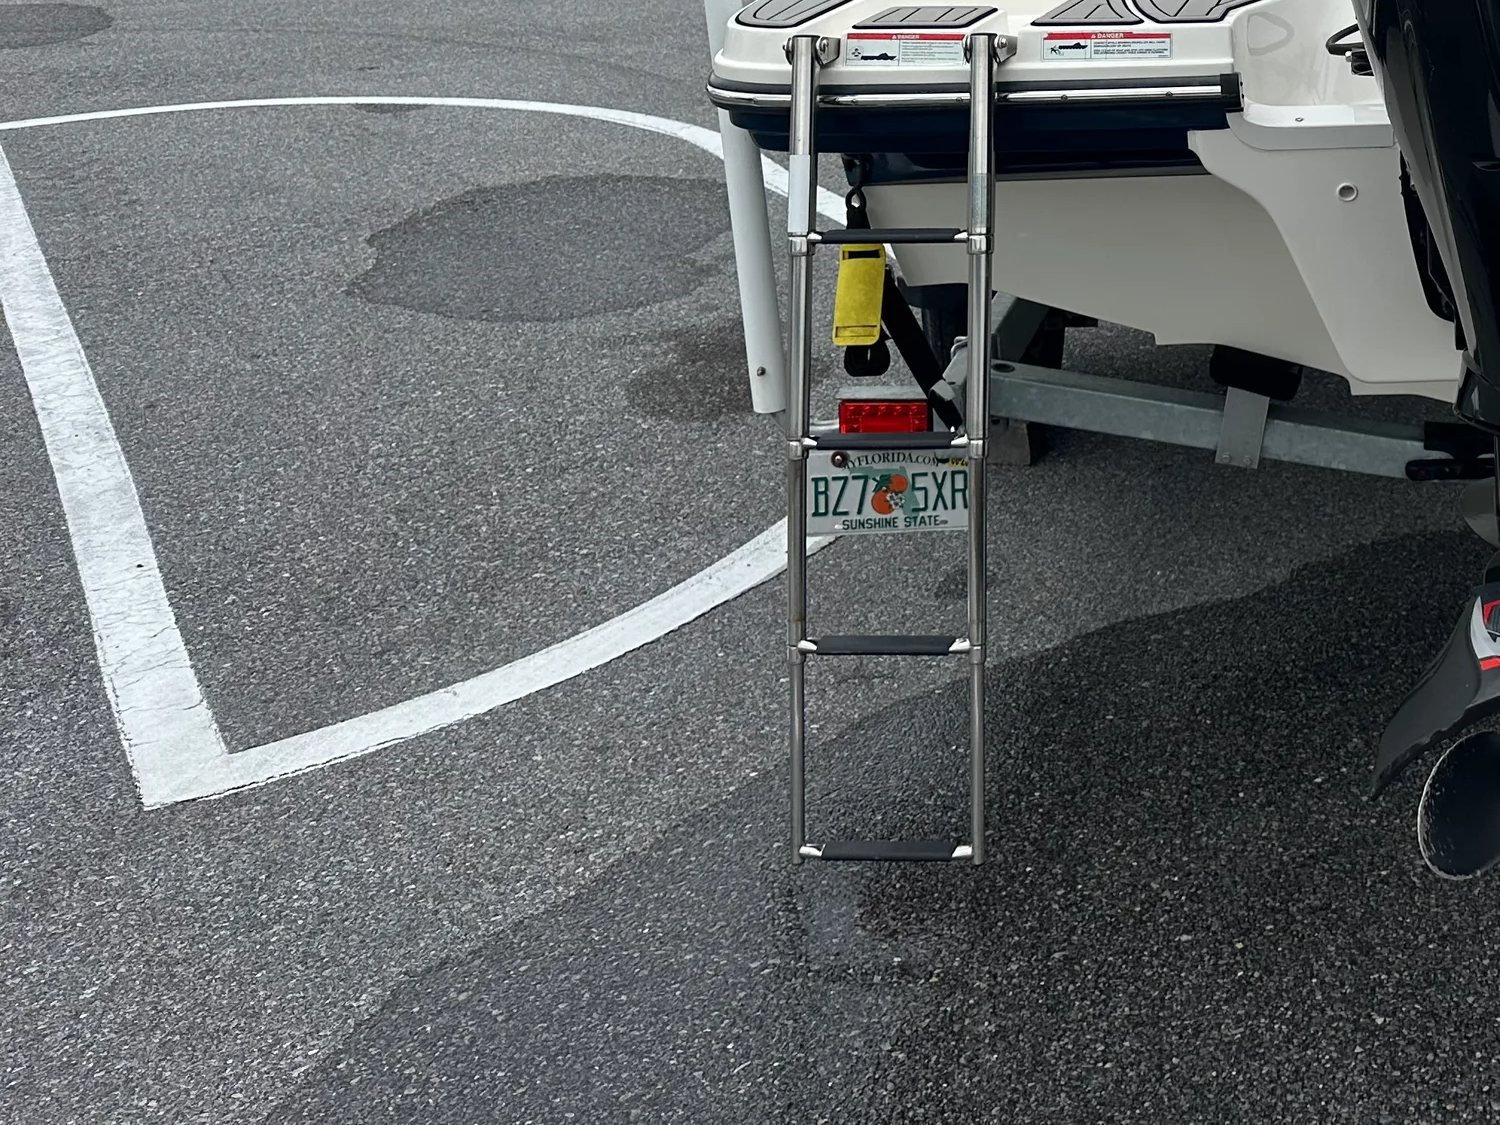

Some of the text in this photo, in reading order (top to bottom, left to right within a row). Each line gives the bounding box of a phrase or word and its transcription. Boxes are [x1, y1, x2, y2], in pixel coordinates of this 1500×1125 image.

[811, 475, 870, 517] BZ7
[842, 514, 941, 531] SUNSHINE STATE
